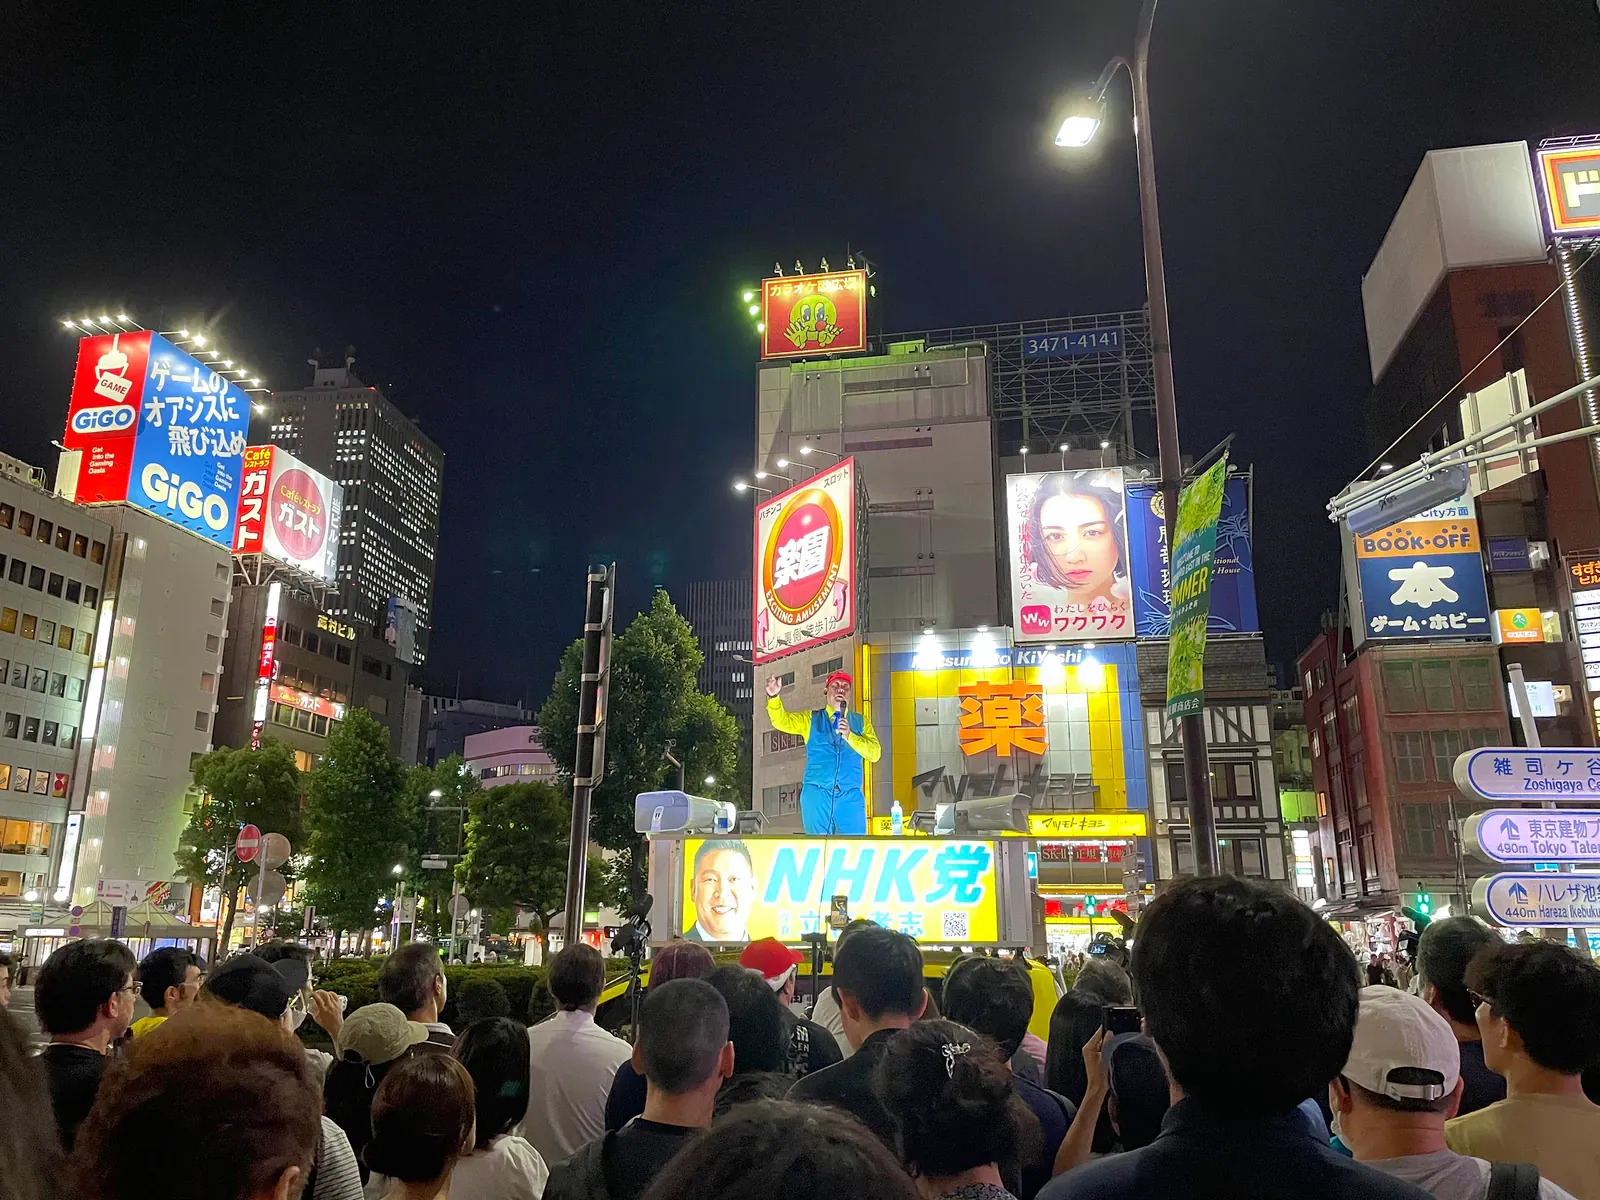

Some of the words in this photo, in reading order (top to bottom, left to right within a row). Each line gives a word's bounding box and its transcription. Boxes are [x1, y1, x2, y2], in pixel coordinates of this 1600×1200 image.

[1028, 331, 1118, 354] 3471-4141
[100, 379, 128, 395] GAME
[150, 361, 229, 394] ゲームの
[75, 408, 133, 430] GiGO
[144, 394, 240, 427] オアシスに
[168, 425, 247, 457] 飛び込め
[89, 459, 114, 468] Gaming
[244, 448, 271, 461] Café
[88, 467, 106, 475] Oasis
[824, 467, 850, 489] スロット
[141, 463, 229, 531] GiGO
[280, 485, 299, 502] Café
[237, 469, 268, 550] ガスト
[278, 502, 321, 539] ガスト
[759, 502, 783, 521] パチンコ
[773, 525, 831, 590] 楽園
[1217, 566, 1241, 575] House
[766, 590, 794, 624] EXCITING
[795, 562, 840, 624] AMUSEMENT
[1171, 566, 1209, 609] MMER
[1388, 561, 1459, 609] 本
[1054, 601, 1127, 613] わたしをひらく
[1054, 614, 1127, 633] ワクワク
[1370, 611, 1487, 633] ゲーム・ホビー
[300, 695, 321, 711] ガスト
[957, 679, 1050, 757] 薬
[911, 764, 1101, 808] マツモトキヨシ
[1523, 778, 1583, 793] Zoshigaya
[1042, 816, 1106, 831] マツモトキヨシ
[1497, 843, 1529, 854] 490m
[1530, 840, 1567, 855] Tokyo
[763, 844, 993, 906] NHK党
[1505, 907, 1537, 918] 440m
[1538, 906, 1568, 918] Hareza
[799, 910, 924, 938] 立孝志
